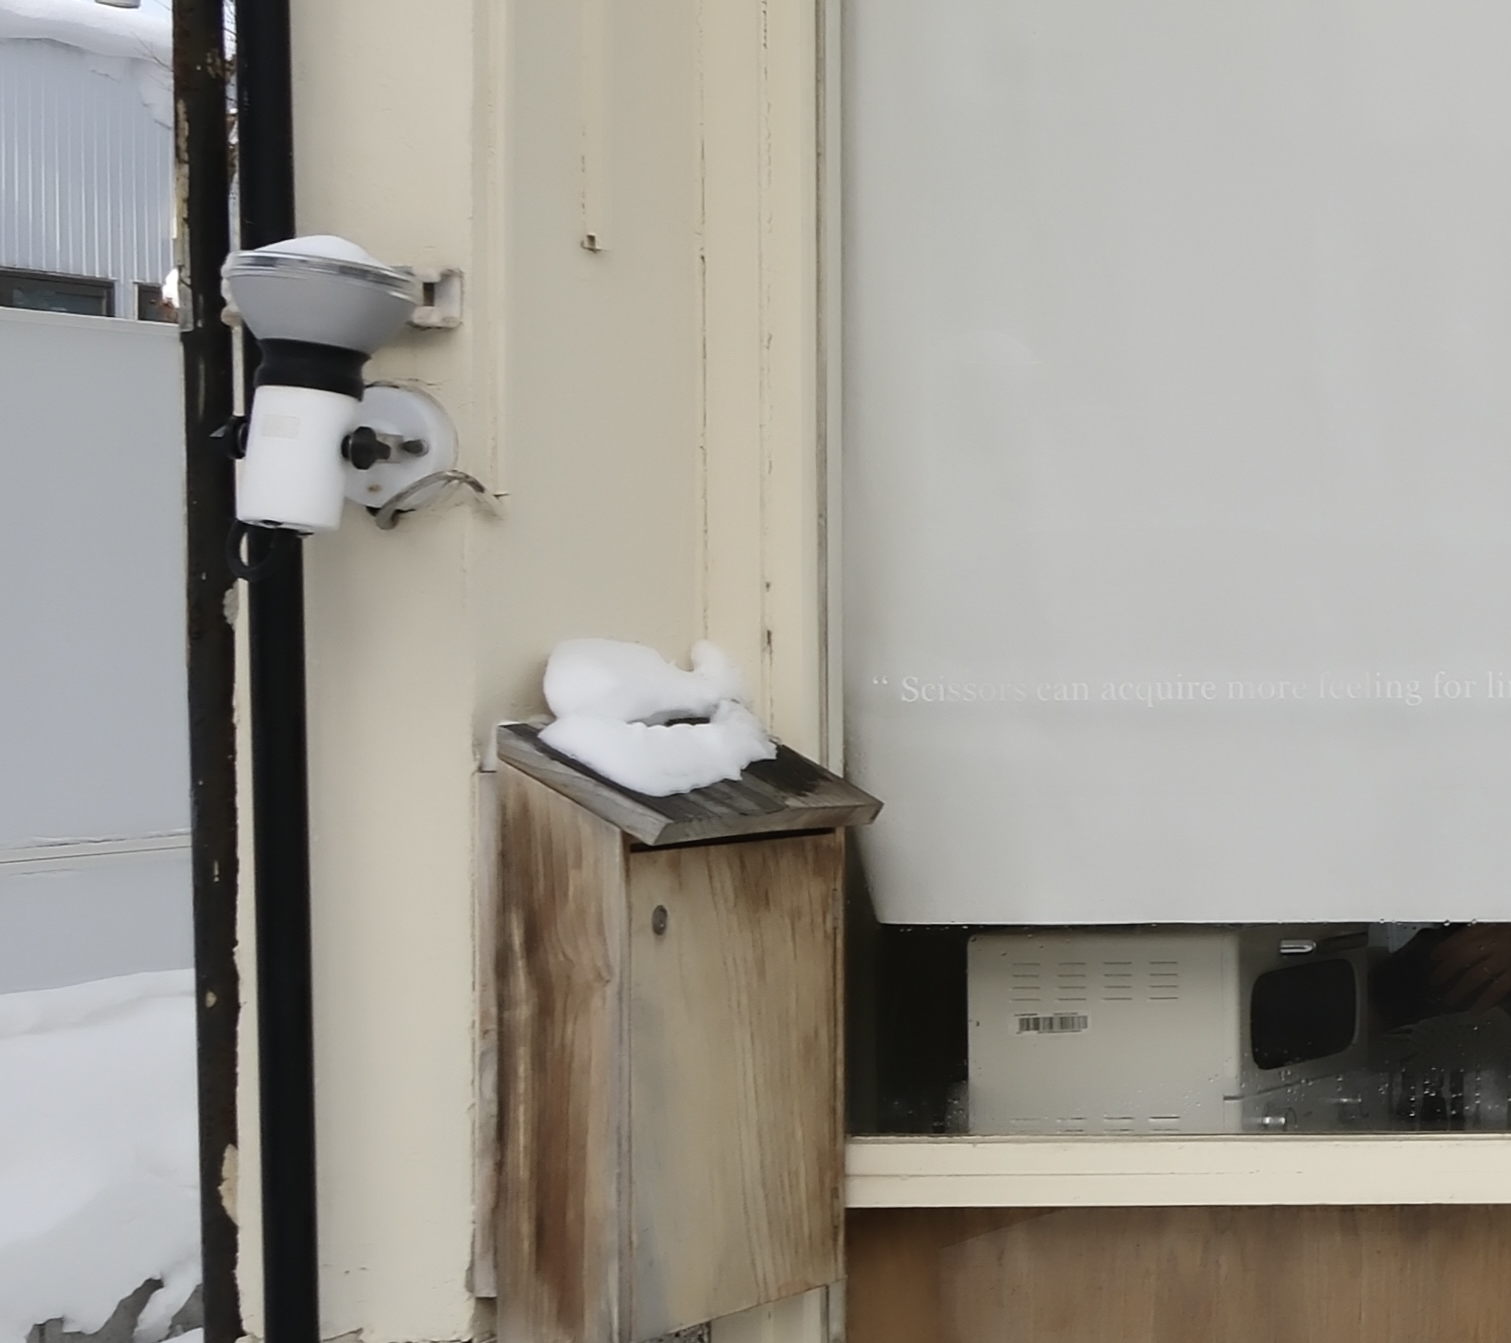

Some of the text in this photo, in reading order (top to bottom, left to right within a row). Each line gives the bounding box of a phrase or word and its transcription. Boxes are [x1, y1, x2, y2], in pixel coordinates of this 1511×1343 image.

[900, 675, 1027, 704] Scissors
[1036, 680, 1090, 703] can
[1101, 673, 1217, 708] acquire
[1226, 679, 1308, 701] more
[1317, 669, 1424, 706] feeling
[1433, 669, 1477, 700] for
